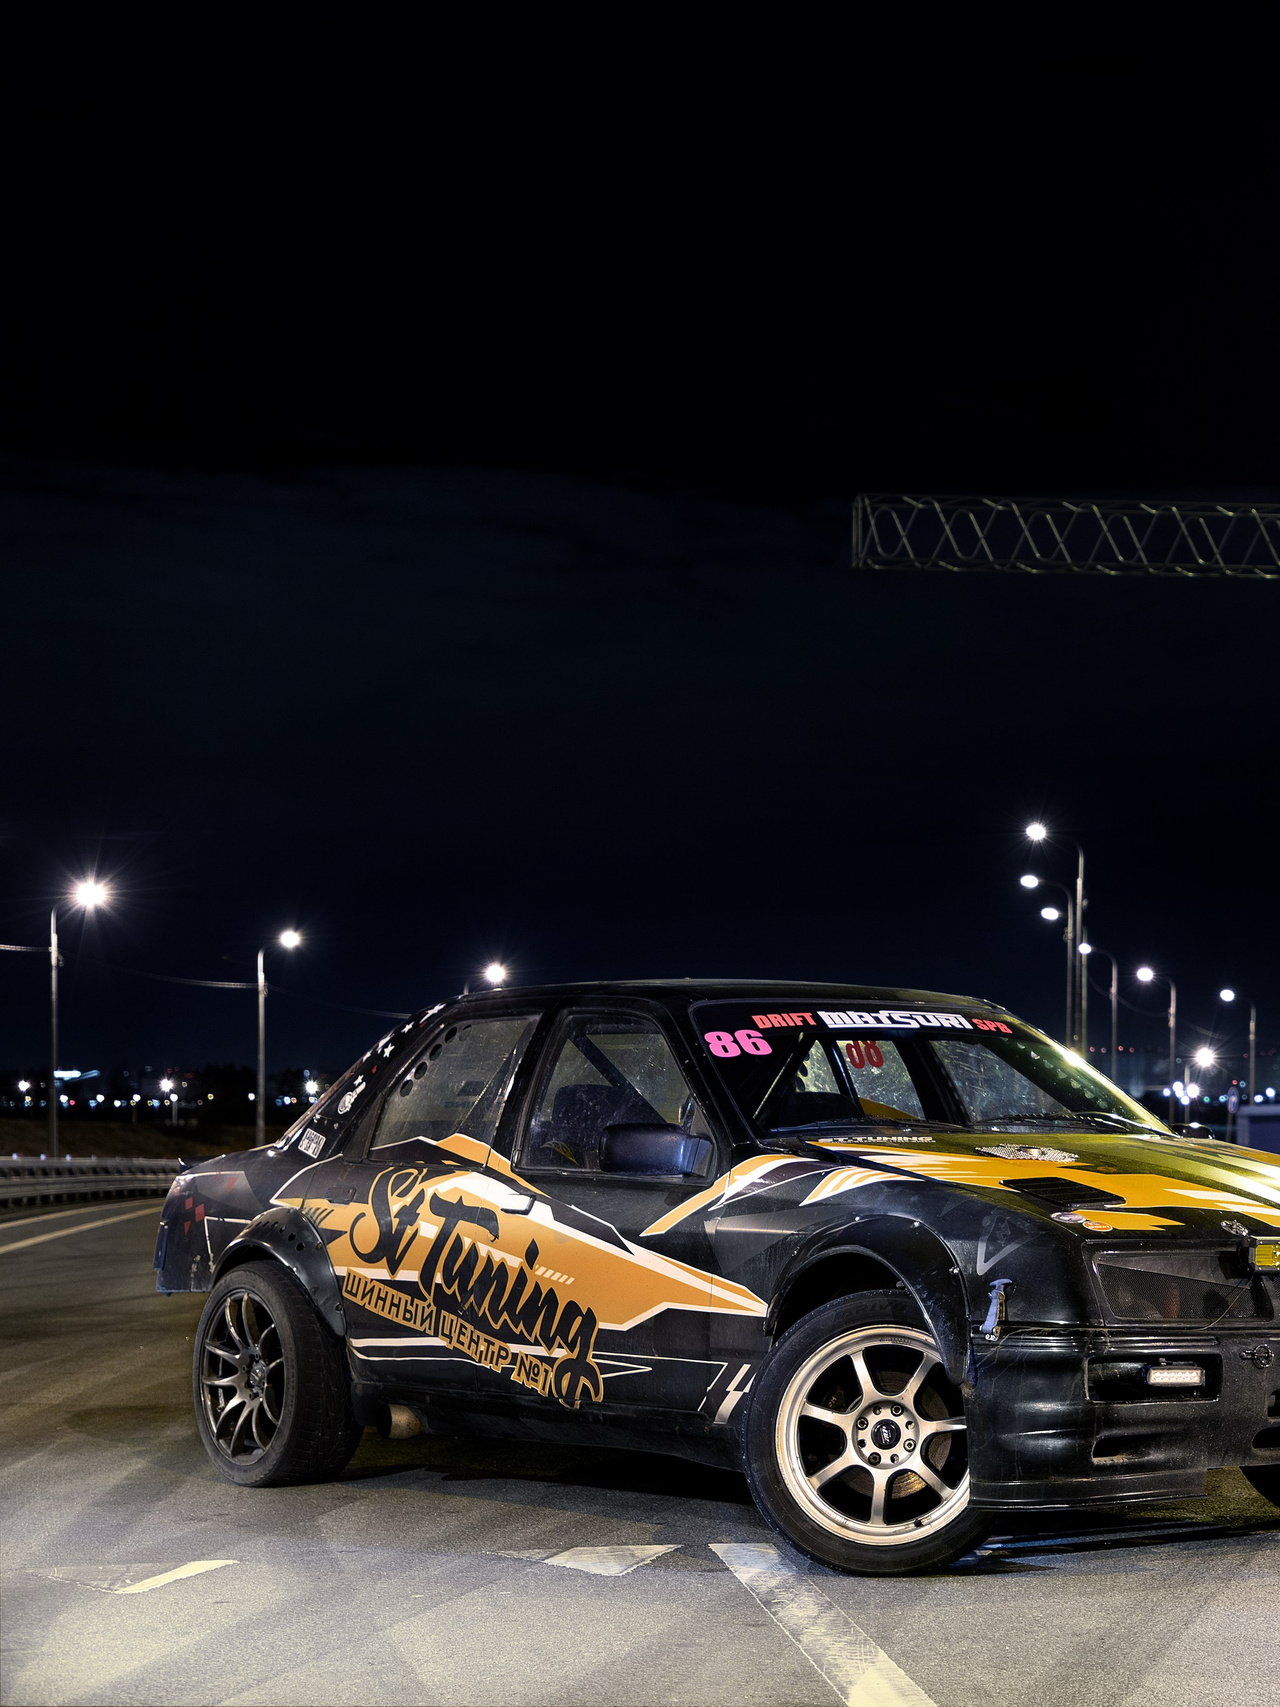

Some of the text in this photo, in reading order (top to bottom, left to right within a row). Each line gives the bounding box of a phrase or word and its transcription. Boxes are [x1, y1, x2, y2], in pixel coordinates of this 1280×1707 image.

[703, 1029, 773, 1058] 86
[751, 1012, 817, 1029] DRIFT
[971, 1017, 1013, 1034] SPB
[417, 1191, 604, 1408] Tuning
[438, 1309, 513, 1374] ЦЕНТР
